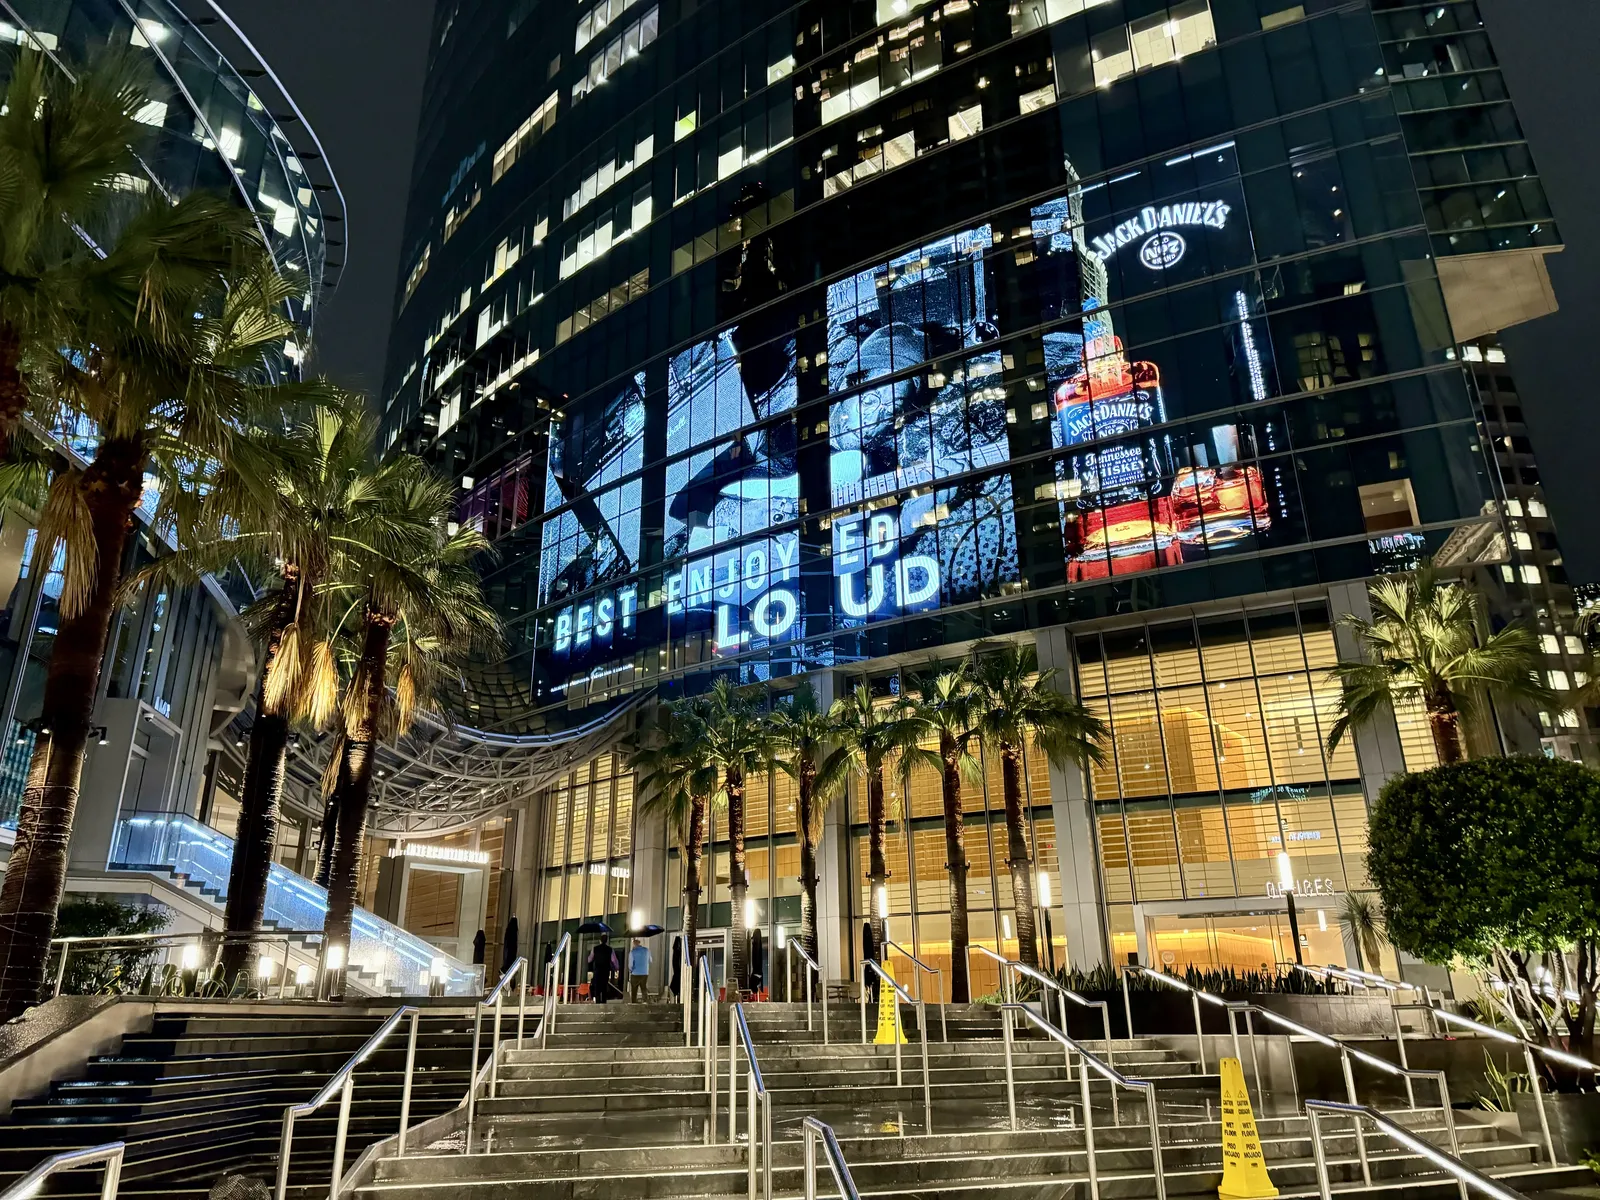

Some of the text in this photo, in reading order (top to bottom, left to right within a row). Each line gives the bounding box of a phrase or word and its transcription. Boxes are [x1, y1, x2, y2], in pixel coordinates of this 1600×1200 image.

[1092, 199, 1231, 260] JACK DANIEL'S
[555, 589, 637, 651] BEST
[1266, 878, 1334, 899] OFICES
